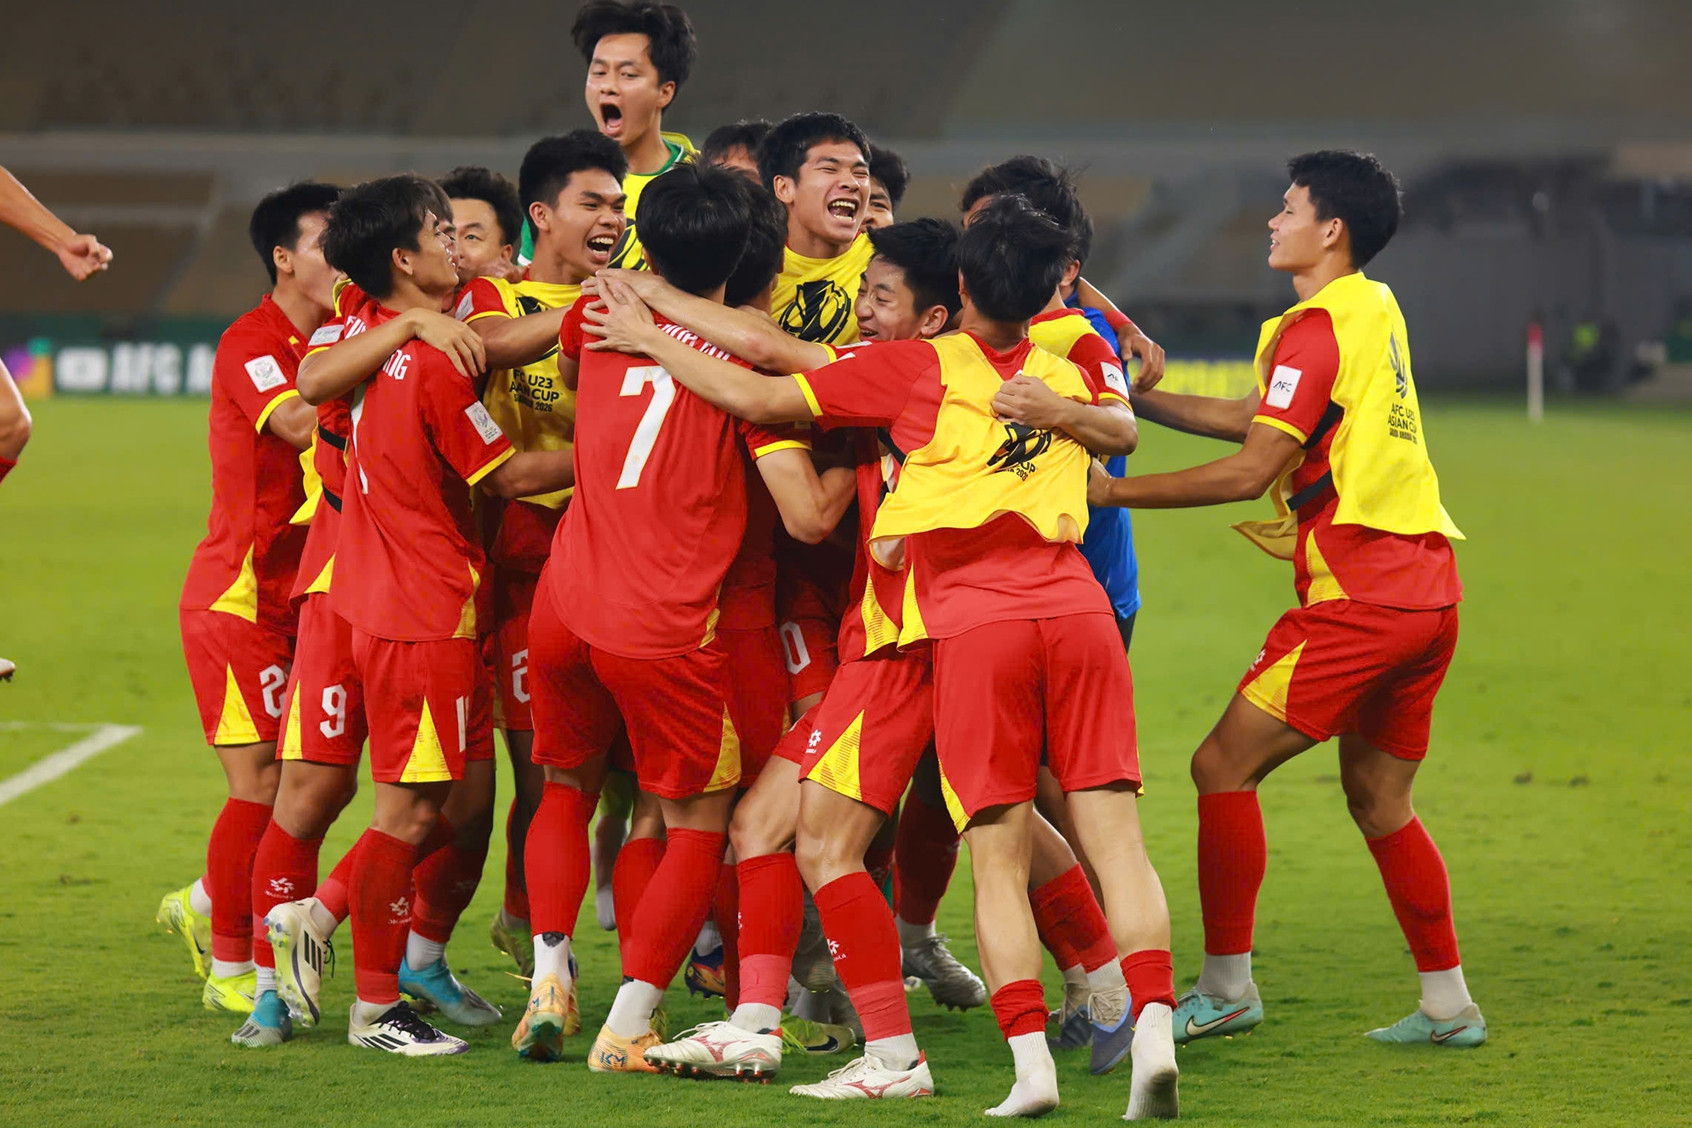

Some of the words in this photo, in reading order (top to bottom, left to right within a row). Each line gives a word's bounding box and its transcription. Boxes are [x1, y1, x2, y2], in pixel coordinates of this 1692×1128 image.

[528, 374, 554, 389] U23
[1273, 380, 1293, 393] AFC
[531, 388, 560, 402] CUP
[1391, 402, 1404, 417] AFC
[615, 365, 677, 490] 7
[319, 684, 347, 739] 9
